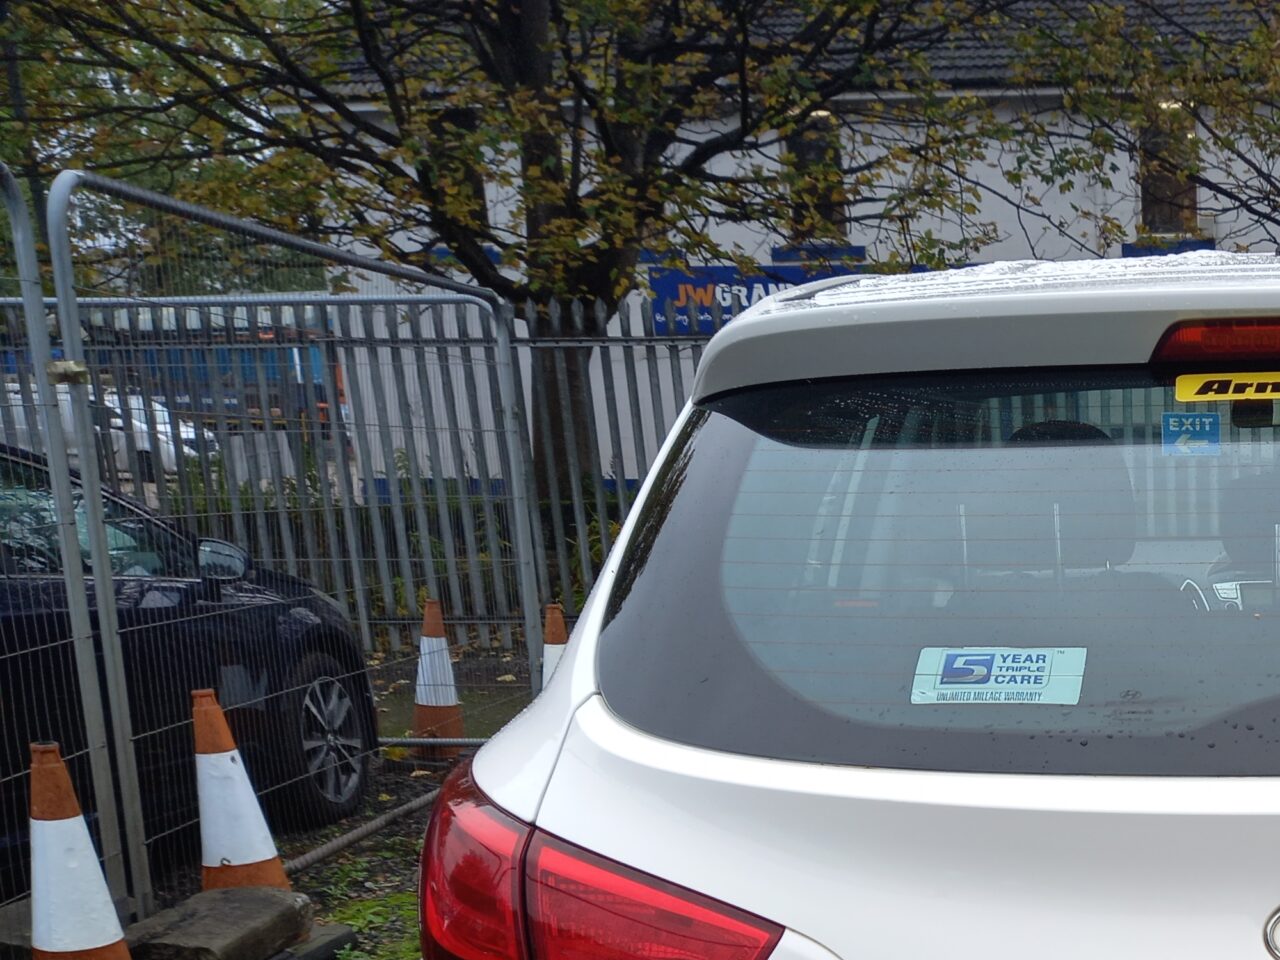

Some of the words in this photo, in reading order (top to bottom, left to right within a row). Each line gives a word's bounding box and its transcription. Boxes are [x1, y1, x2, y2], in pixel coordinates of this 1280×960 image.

[1168, 416, 1214, 433] EXIT
[941, 655, 991, 683] 5
[999, 653, 1047, 664] YEAR
[996, 665, 1046, 673] TRIPLE
[994, 674, 1044, 685] CARE
[936, 691, 972, 702] UNLIMITED
[972, 691, 1003, 702] MILEAGE
[1003, 691, 1043, 702] WARRANTY
